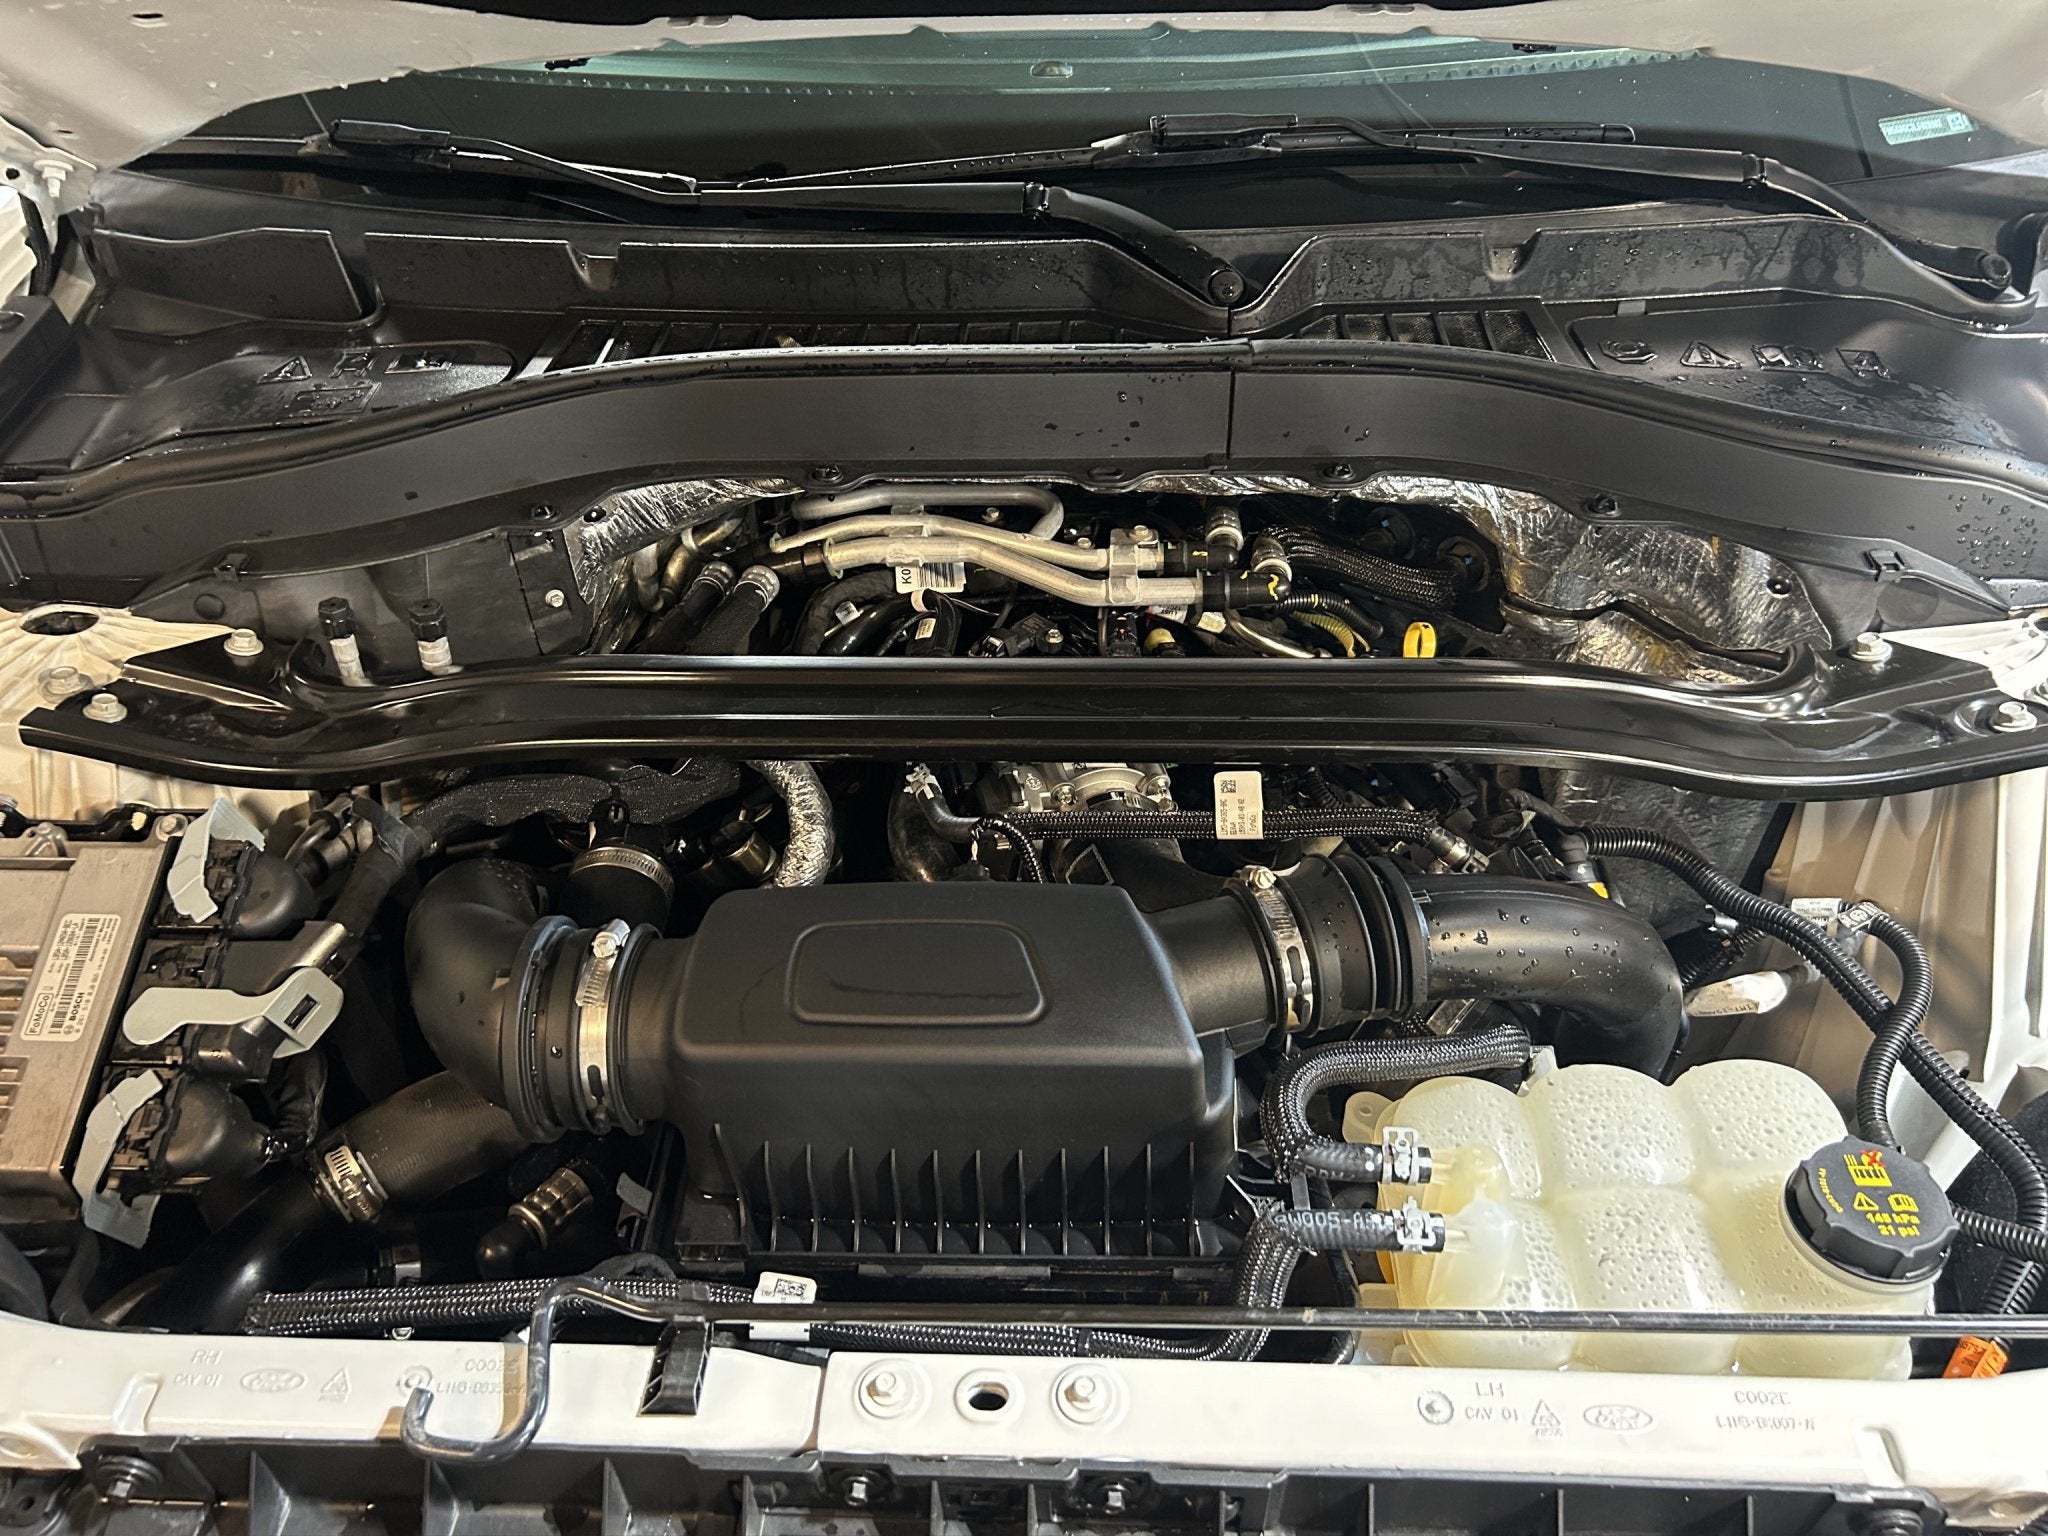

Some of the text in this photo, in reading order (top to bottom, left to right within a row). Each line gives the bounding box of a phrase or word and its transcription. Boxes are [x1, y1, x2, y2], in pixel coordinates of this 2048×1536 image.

[901, 566, 912, 584] K0
[30, 995, 50, 1032] FoMoCo
[69, 992, 85, 1020] BOSCH
[1878, 1224, 1896, 1236] 21
[191, 1348, 223, 1365] RH
[1475, 1381, 1505, 1398] LH
[1464, 1406, 1493, 1420] CAV
